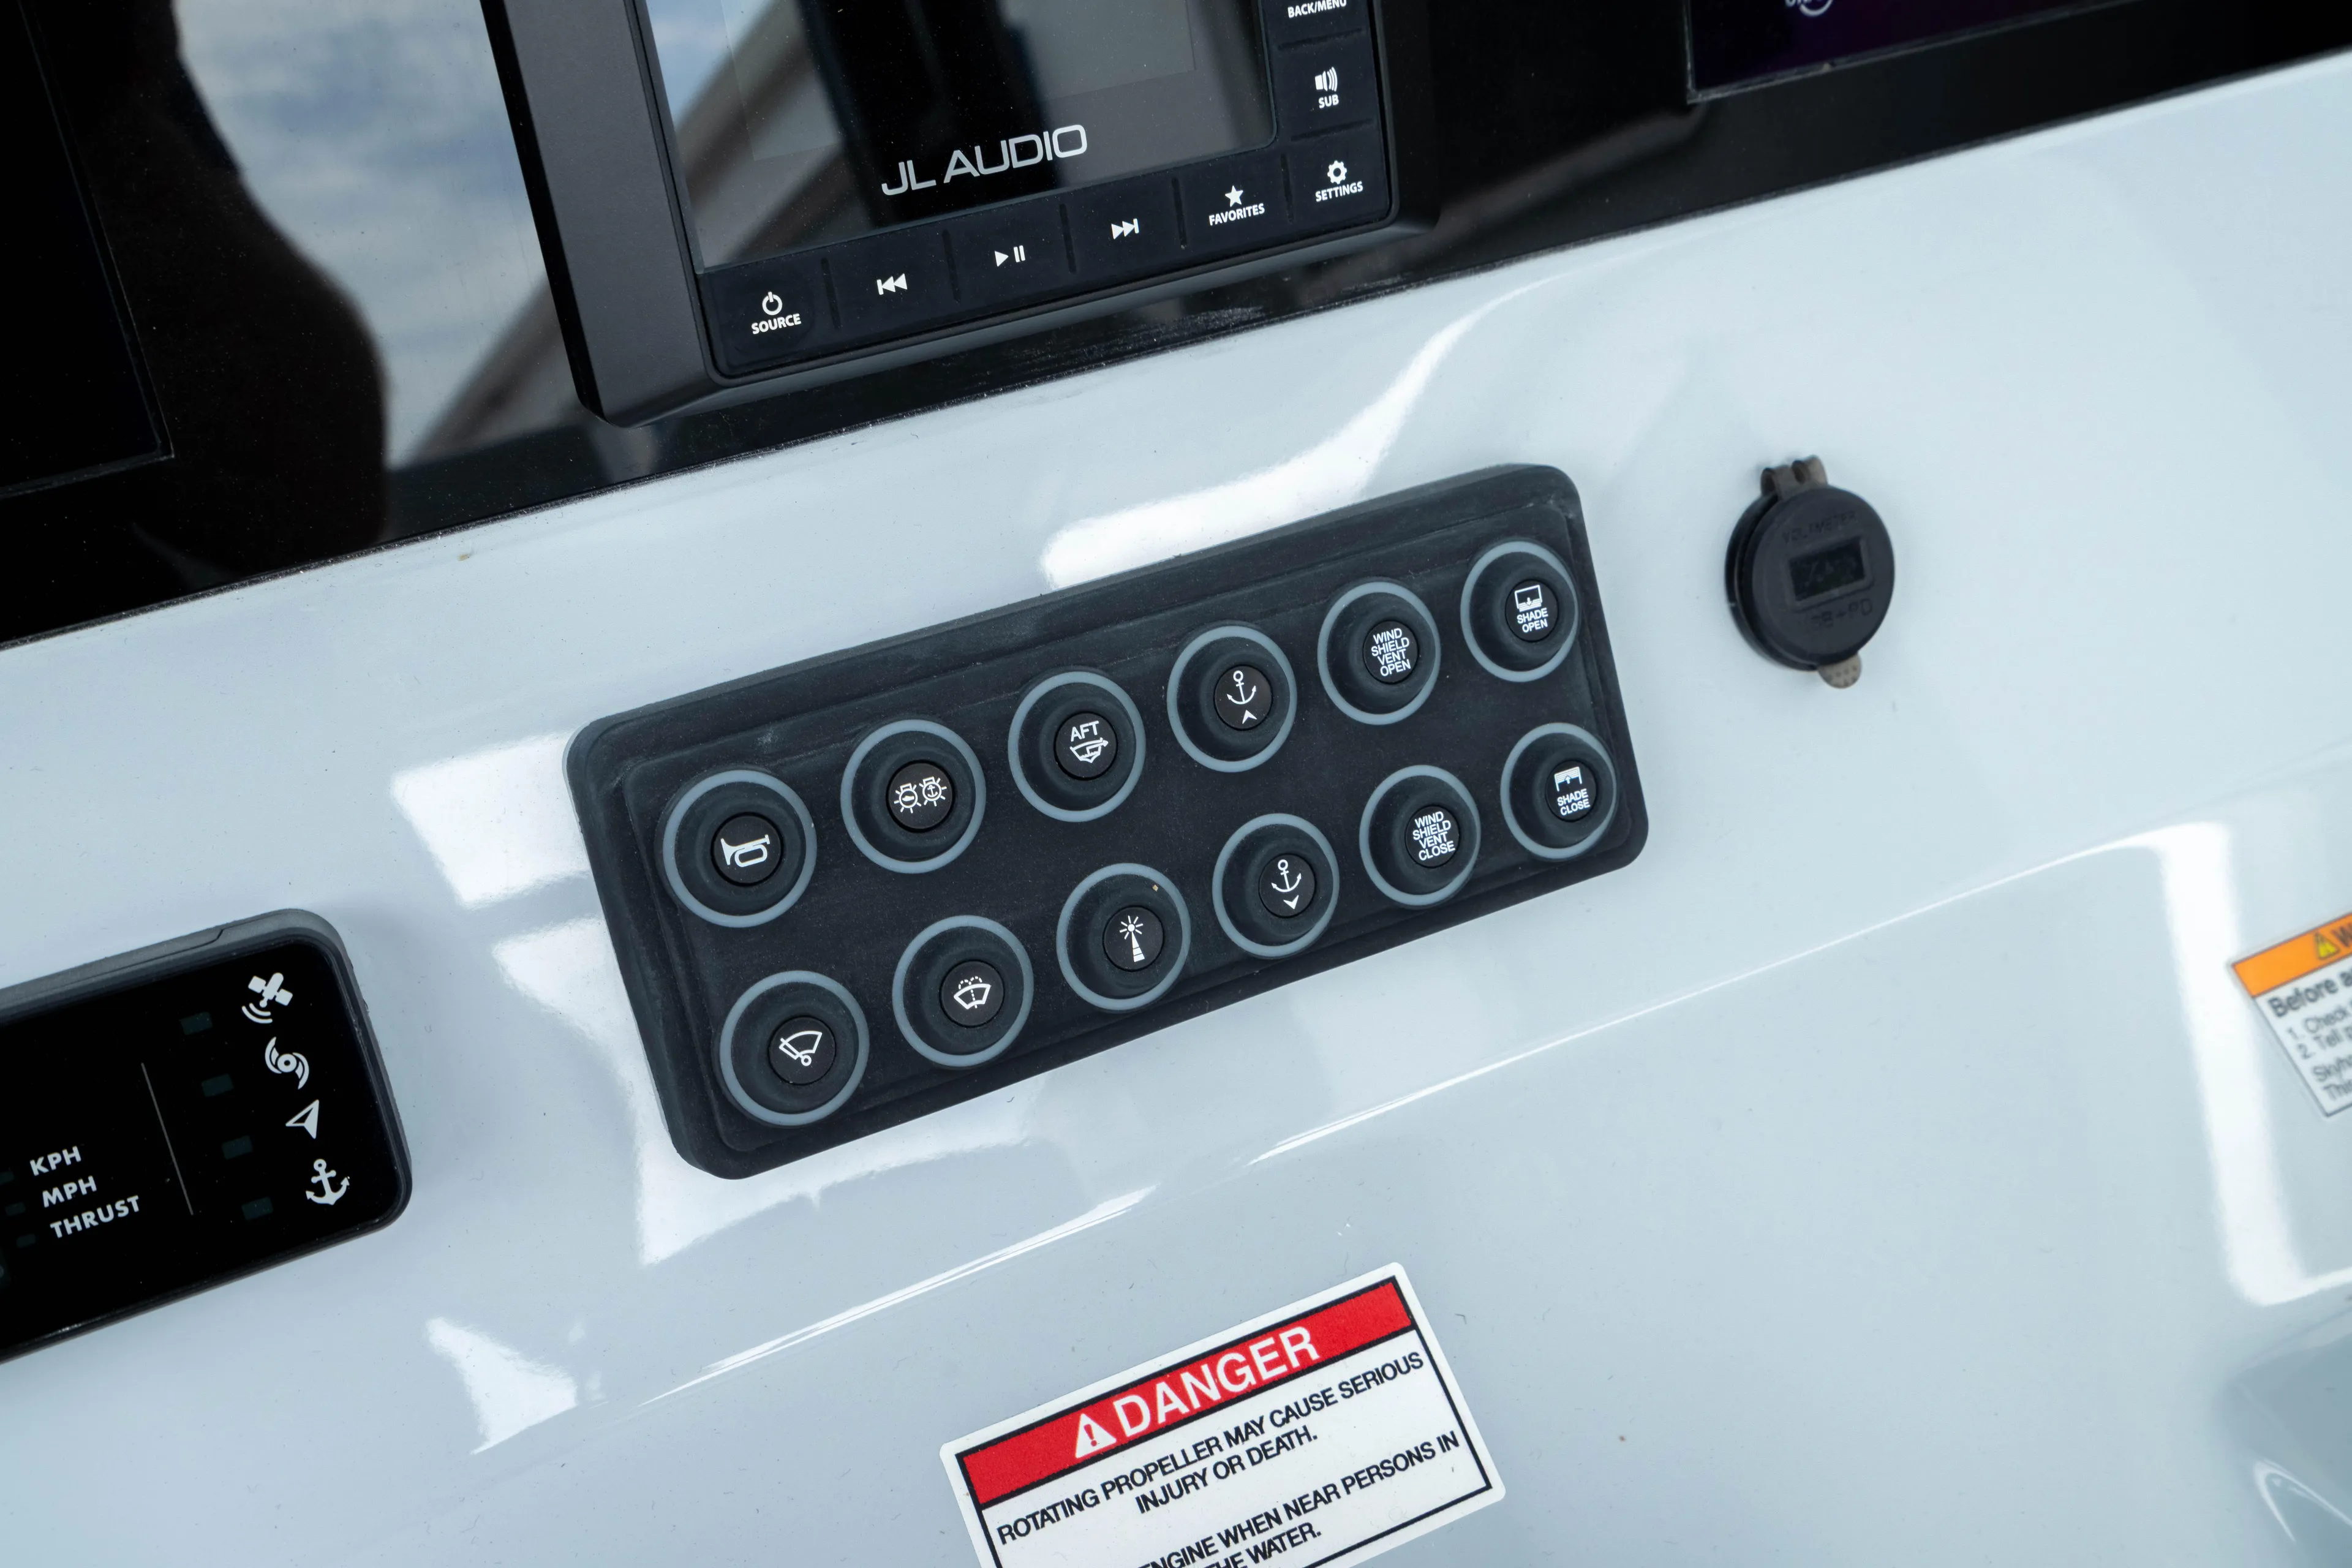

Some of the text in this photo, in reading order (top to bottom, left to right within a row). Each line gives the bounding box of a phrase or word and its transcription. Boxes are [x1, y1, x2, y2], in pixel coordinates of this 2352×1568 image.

[1287, 0, 1347, 18] BACK/MENU
[1319, 92, 1340, 108] SUB
[881, 123, 1088, 196] JL AUDIO
[1315, 181, 1364, 203] SETTINGS
[1208, 203, 1265, 226] FAVORITES
[751, 312, 802, 335] SOURCE
[1517, 607, 1548, 624] SHADE
[1521, 618, 1548, 633] OPEN
[1373, 628, 1403, 644] WIND
[1371, 637, 1410, 657] SHIELD
[1377, 648, 1406, 665] VENT
[1380, 658, 1411, 677] OPEN
[1071, 720, 1099, 742] AFT
[1557, 788, 1589, 806] SHADE
[1560, 798, 1591, 816] CLOSE
[1412, 820, 1451, 840] SHIELD
[1414, 811, 1444, 829] WIND
[1419, 831, 1448, 849] VENT
[1419, 840, 1456, 861] CLOSE
[2267, 979, 2339, 1017] Before
[29, 1146, 82, 1176] KPH
[42, 1176, 97, 1208] MPH
[50, 1195, 141, 1238] THRUST
[1112, 1325, 1321, 1438] DANGER
[996, 1352, 1424, 1545] ROTATING PROPELLER MAY CAUSE SERIOUS
[1134, 1425, 1318, 1514] INJURY OR DEATH.
[1137, 1536, 1219, 1568] GINE
[1216, 1507, 1283, 1548] WHEN
[1283, 1483, 1341, 1520] NEAR
[1340, 1441, 1436, 1495] PERSONS
[1436, 1430, 1460, 1453] IN
[1245, 1521, 1322, 1564] WATER.
